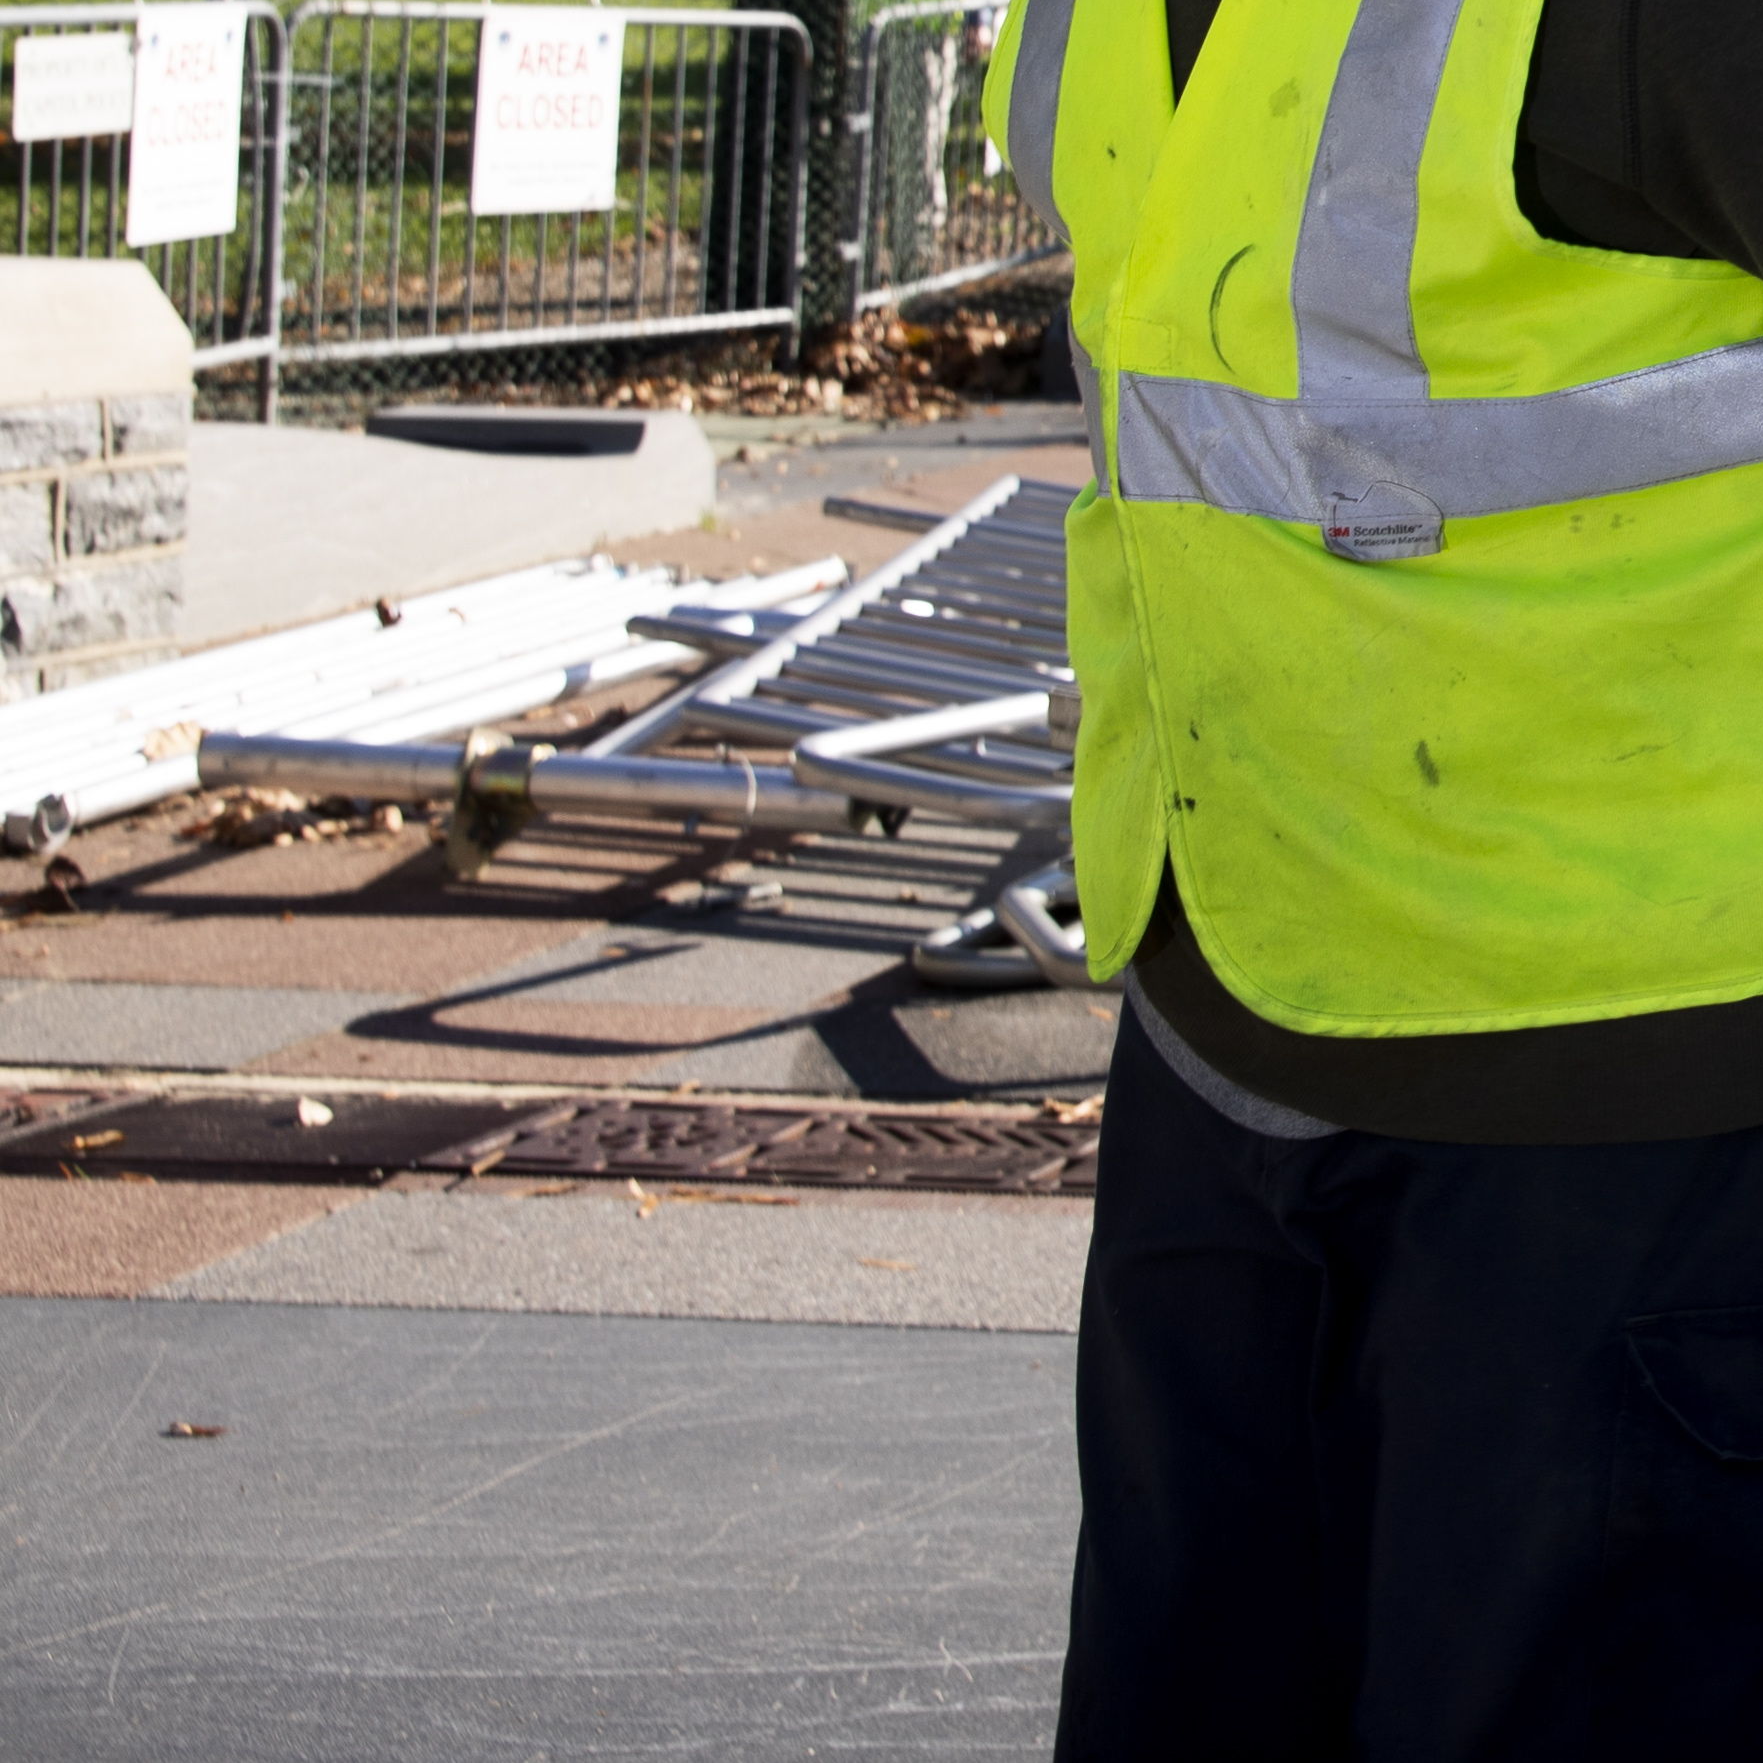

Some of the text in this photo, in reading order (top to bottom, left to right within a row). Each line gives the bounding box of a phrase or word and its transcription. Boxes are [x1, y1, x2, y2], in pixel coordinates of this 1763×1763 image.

[516, 41, 590, 78] AREA
[495, 93, 605, 130] CLOSED
[1328, 526, 1350, 537] 3M
[1354, 537, 1396, 547] Reflective
